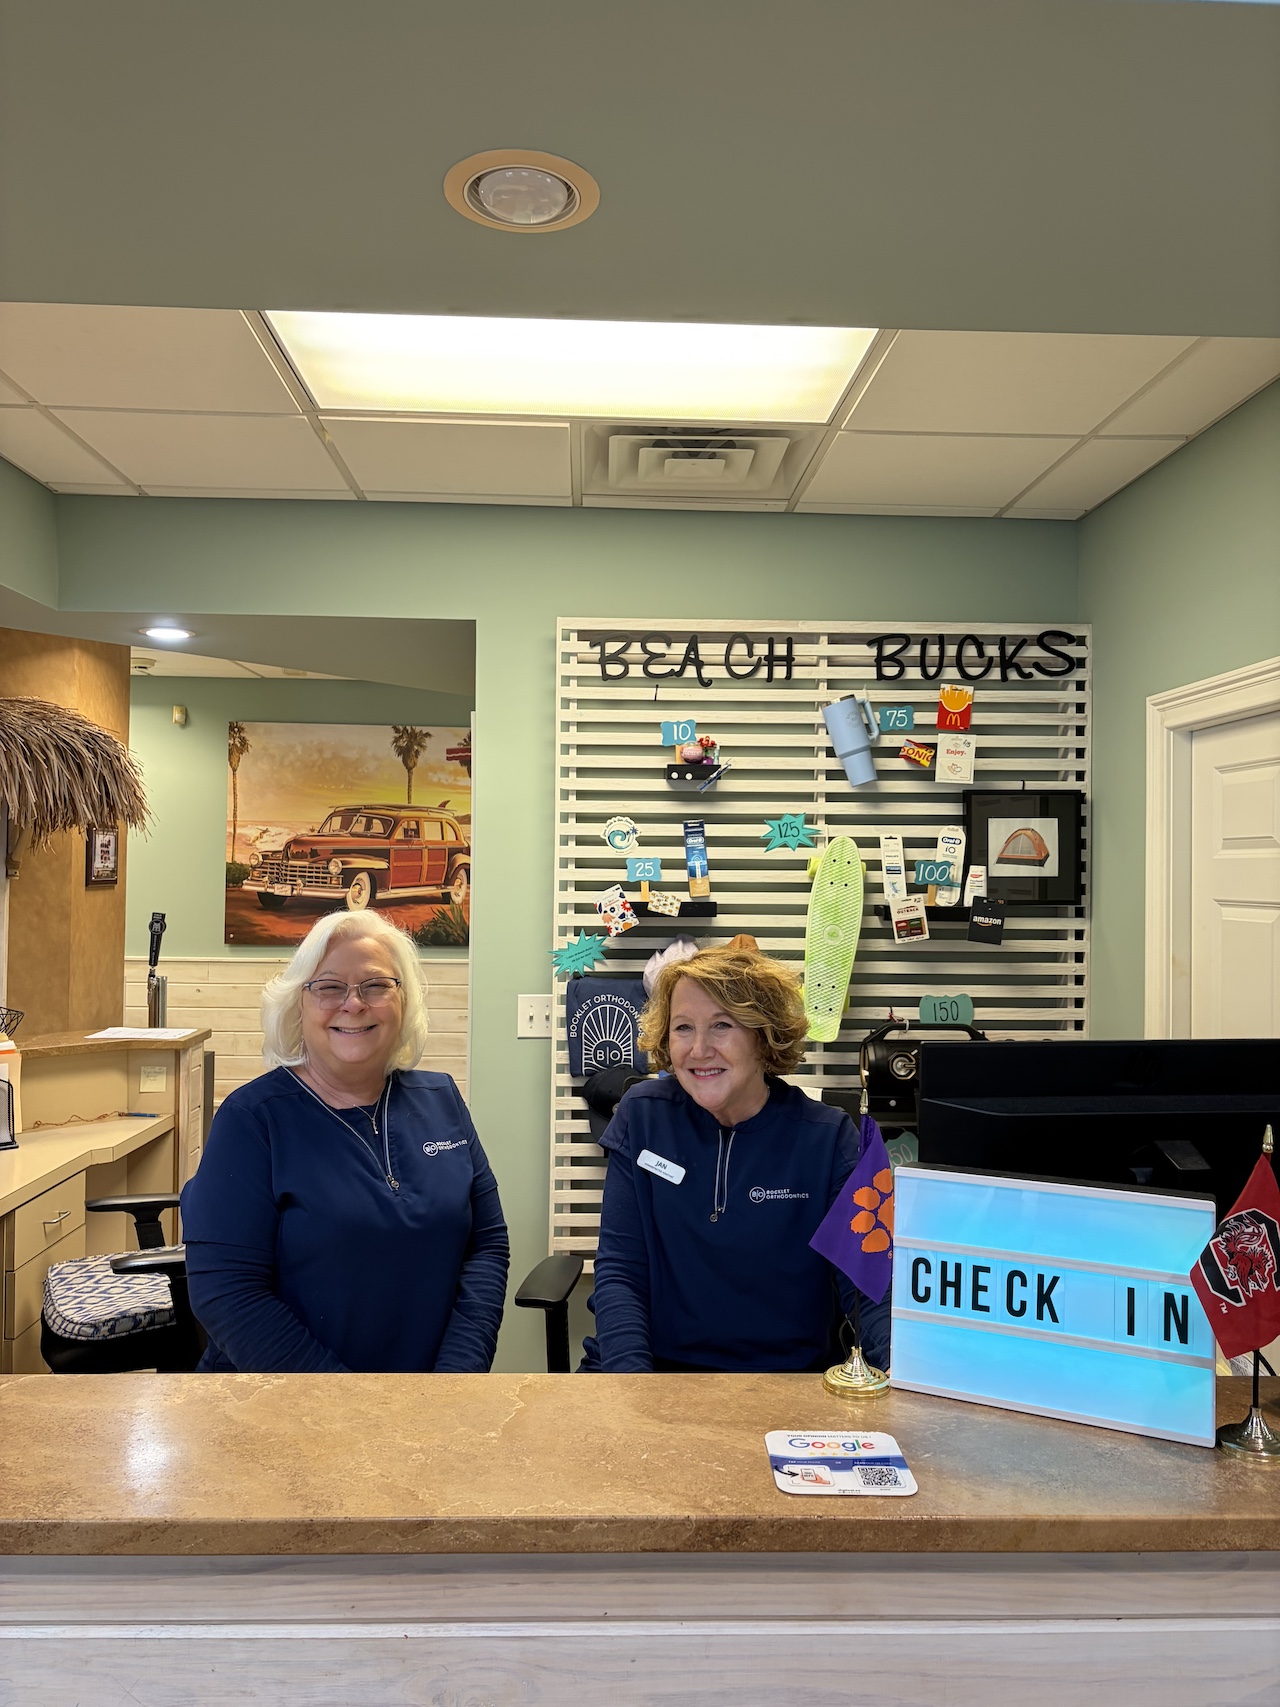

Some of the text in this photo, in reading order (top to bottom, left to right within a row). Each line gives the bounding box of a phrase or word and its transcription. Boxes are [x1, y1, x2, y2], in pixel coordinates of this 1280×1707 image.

[589, 629, 1077, 688] BEACH BUCKS
[886, 709, 908, 727] 75
[673, 723, 692, 741] 10
[777, 820, 801, 839] 125
[635, 861, 655, 877] 25
[918, 863, 949, 882] 100
[972, 915, 1002, 925] amazon
[933, 1000, 959, 1022] 150
[655, 1160, 668, 1170] JAN
[911, 1256, 1190, 1345] CHECK IN
[1219, 1301, 1229, 1314] TM
[788, 1437, 875, 1452] Google
